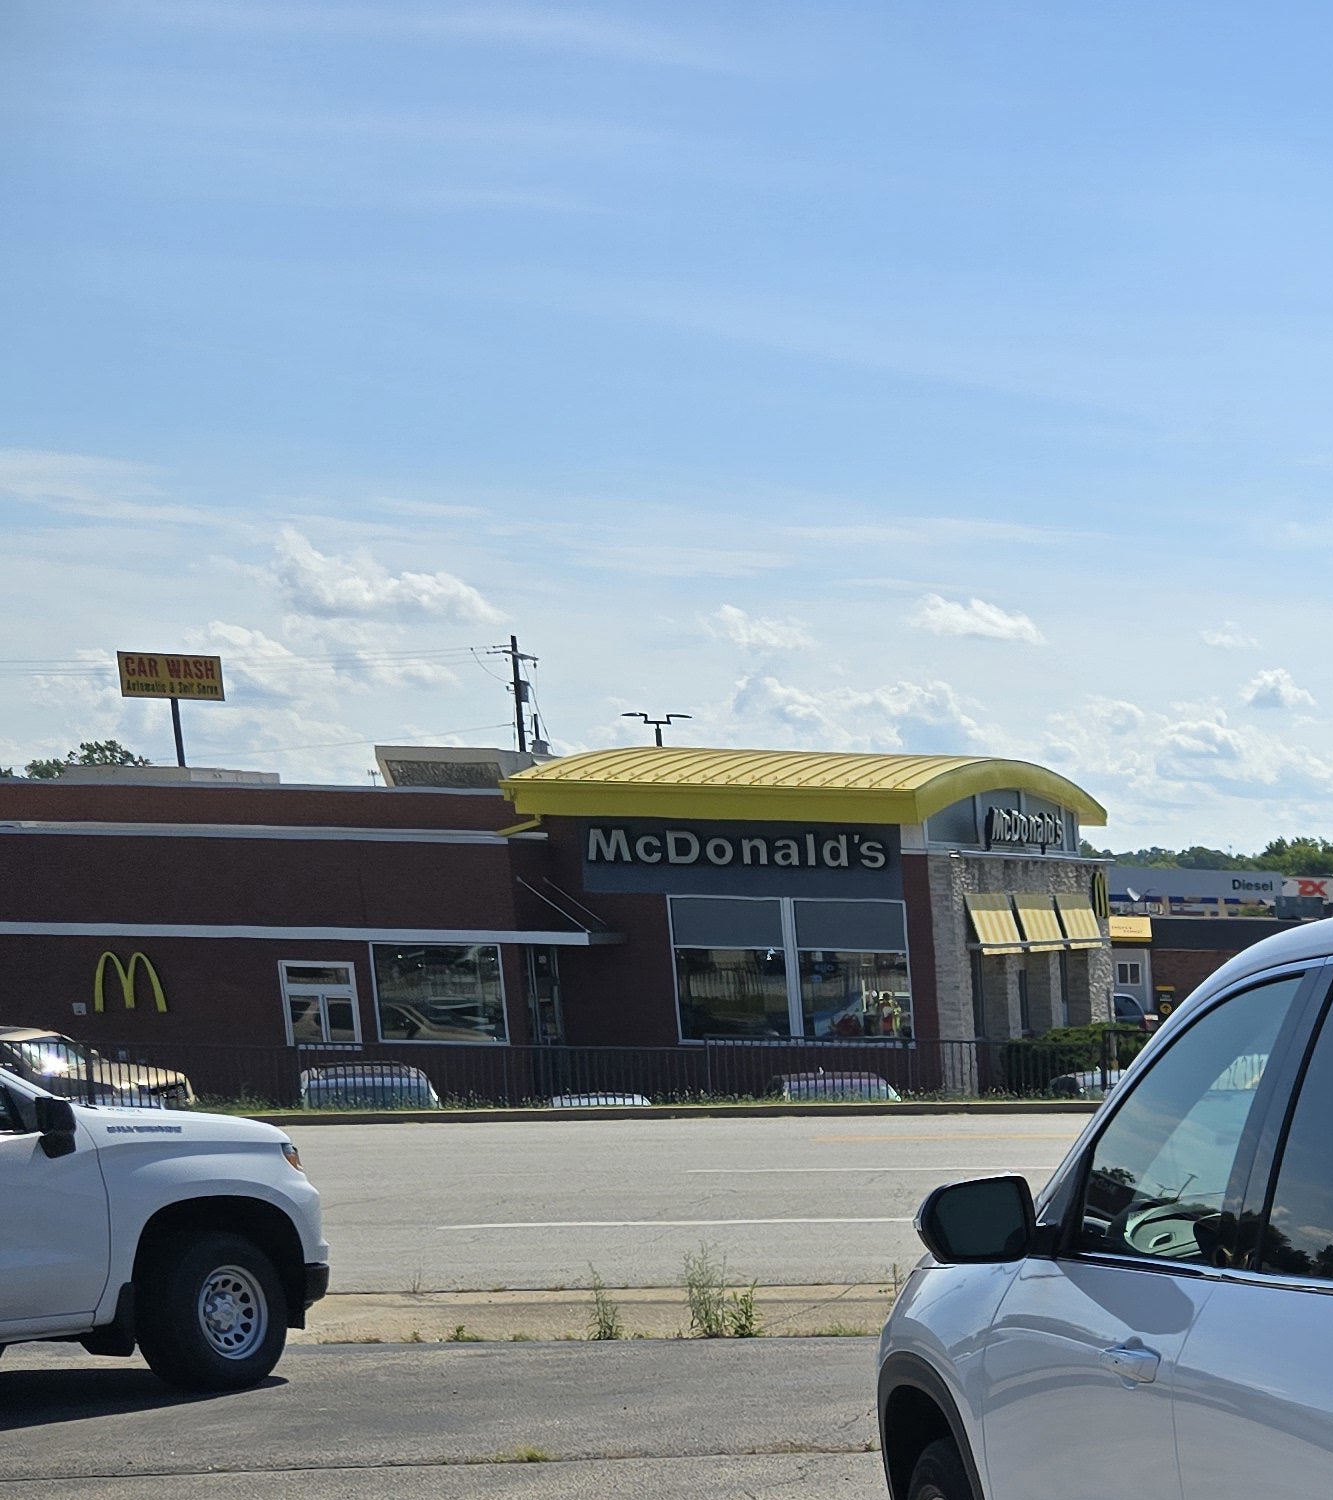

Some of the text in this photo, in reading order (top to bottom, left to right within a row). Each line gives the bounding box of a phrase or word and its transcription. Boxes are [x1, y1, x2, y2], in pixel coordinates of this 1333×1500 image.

[124, 656, 216, 680] CAR WASH
[127, 680, 167, 693] Automatic
[991, 808, 1064, 846] McDonald's
[587, 828, 887, 869] McDonald's
[1231, 878, 1273, 892] Diesel
